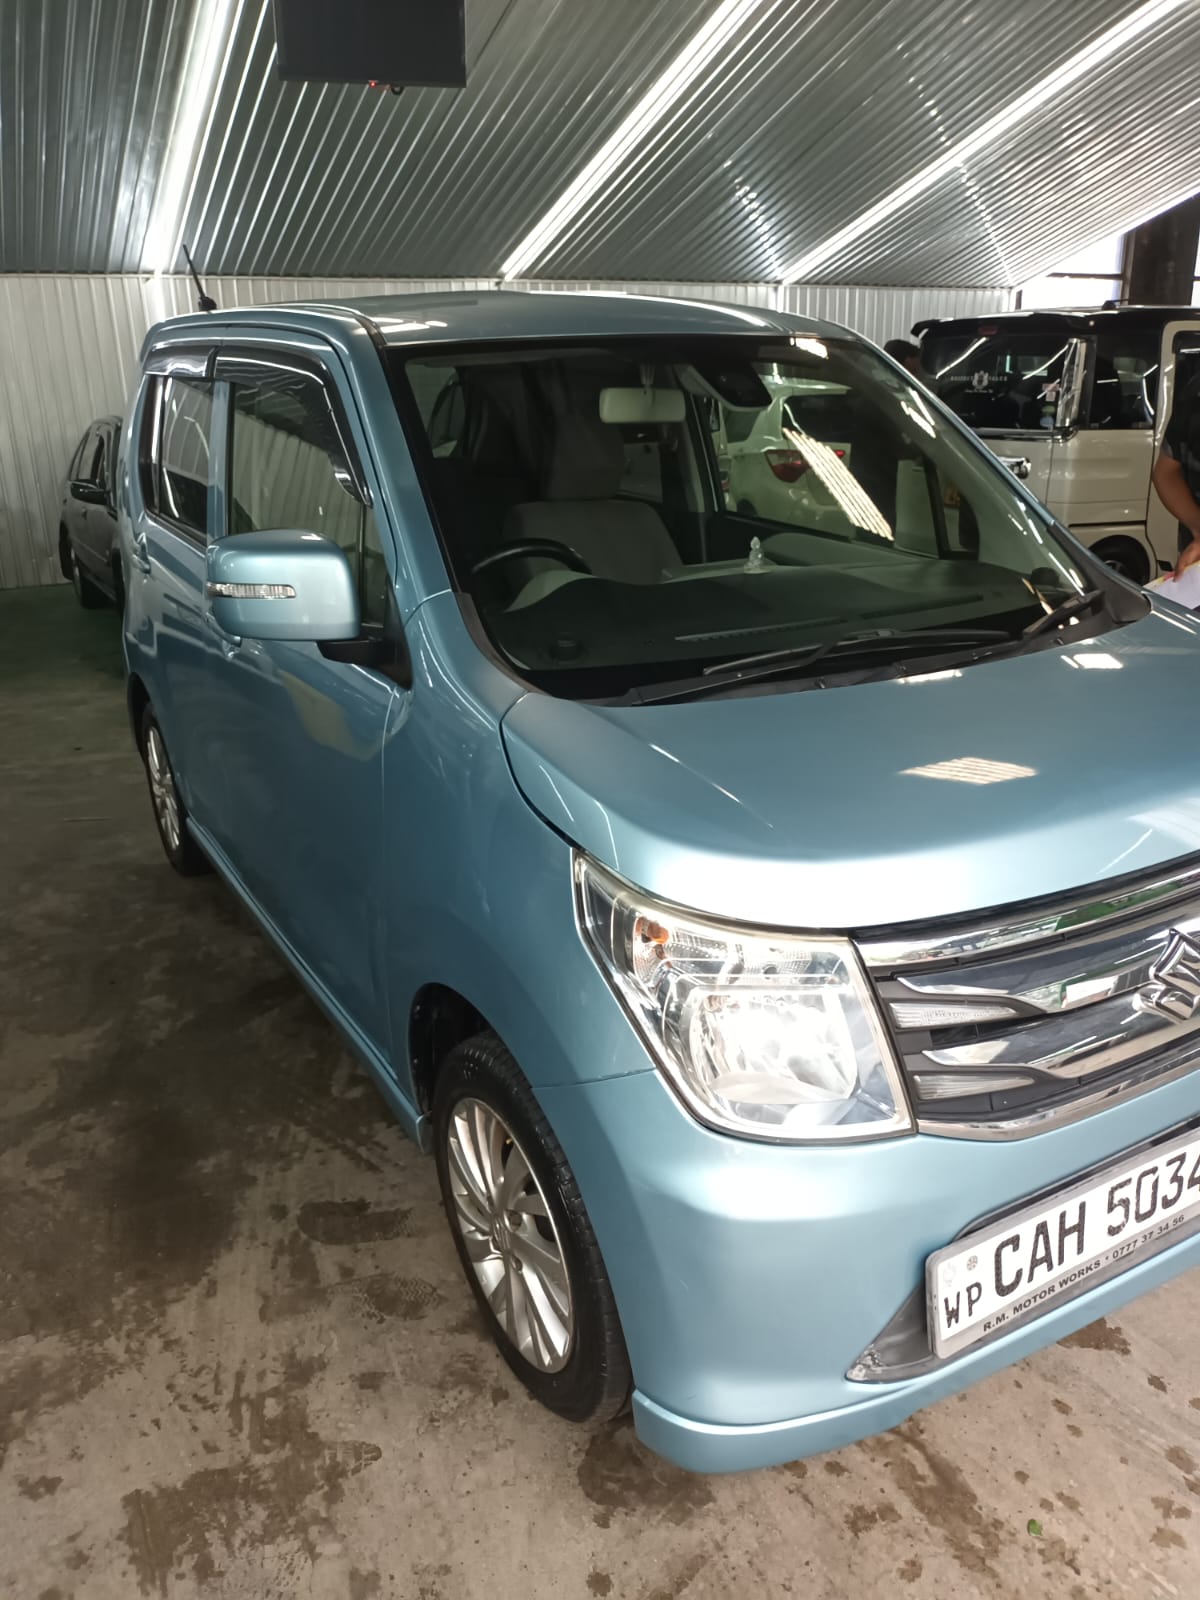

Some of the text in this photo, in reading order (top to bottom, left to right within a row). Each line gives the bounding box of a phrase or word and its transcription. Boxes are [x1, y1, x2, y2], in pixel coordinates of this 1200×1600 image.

[984, 1313, 1009, 1332] R.M.
[1013, 1285, 1055, 1315] MOTOR
[1059, 1260, 1100, 1287] WORKS
[1112, 1239, 1138, 1259] 0777
[1142, 1231, 1154, 1243] 37
[1158, 1222, 1170, 1234] 34
[994, 1201, 1086, 1297] CAH
